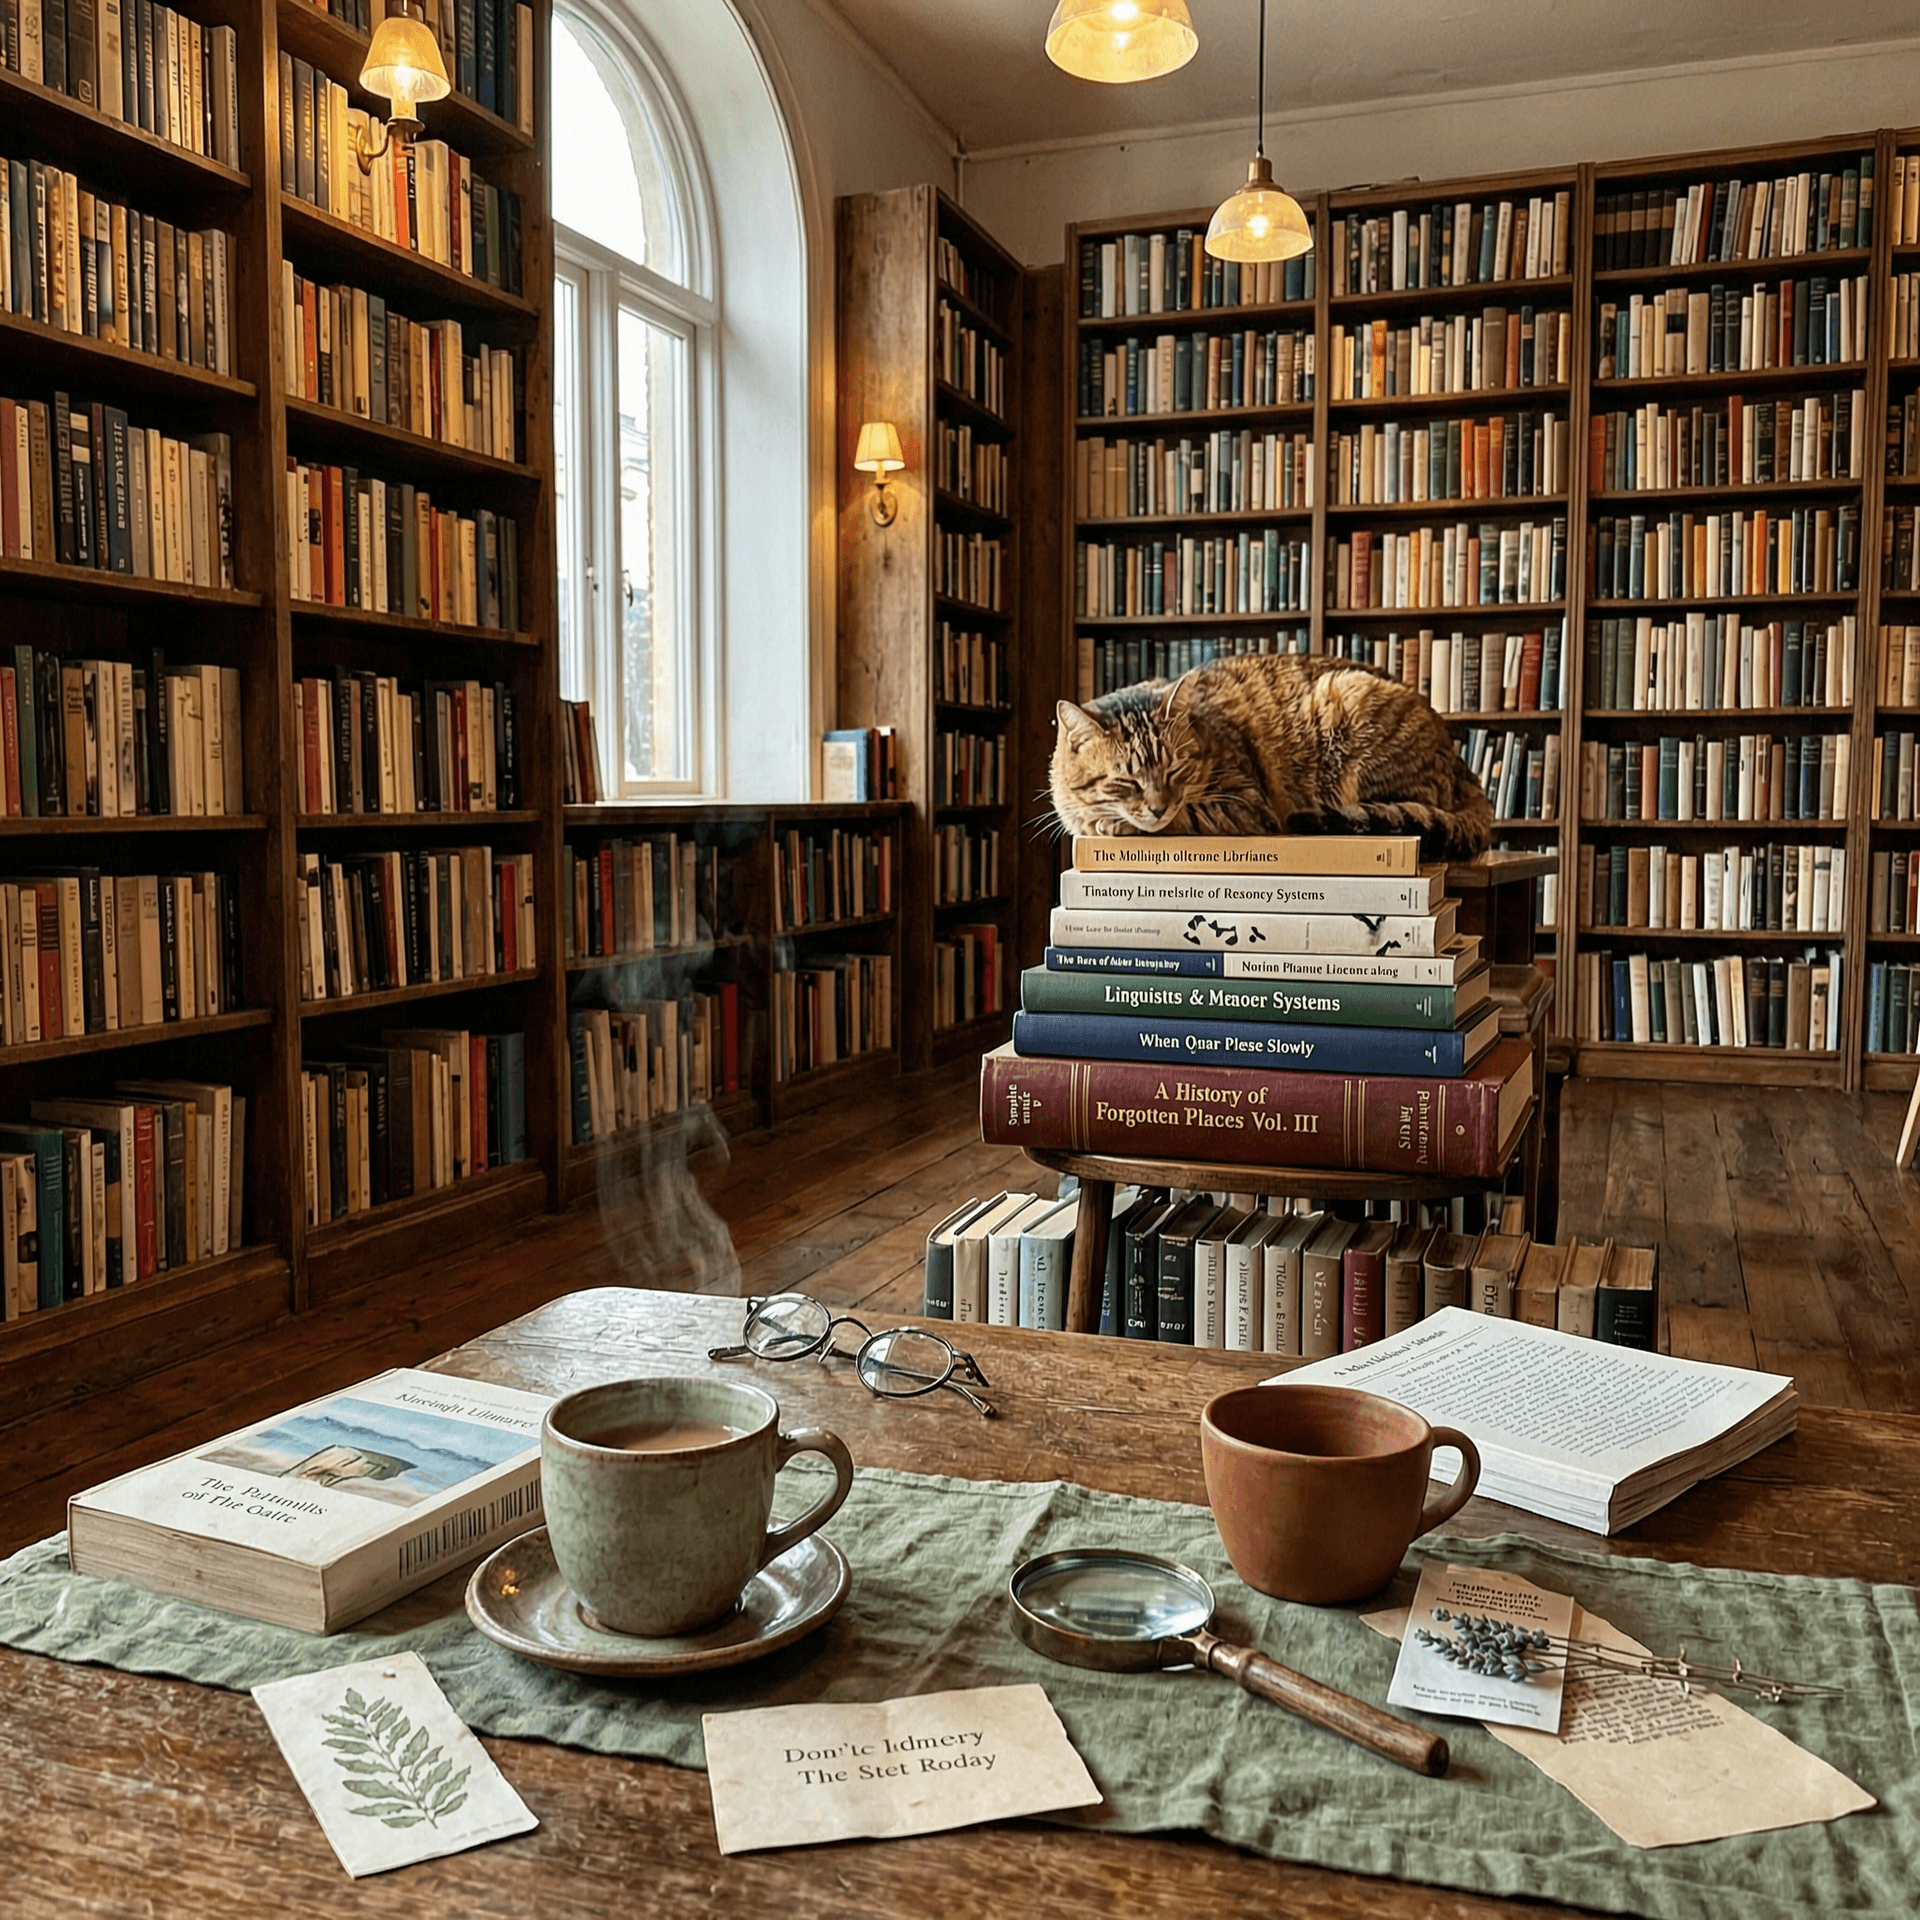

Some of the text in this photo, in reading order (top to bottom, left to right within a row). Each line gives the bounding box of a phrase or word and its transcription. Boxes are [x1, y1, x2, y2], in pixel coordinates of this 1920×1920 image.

[1094, 850, 1115, 862] The
[1208, 888, 1221, 899] of
[1277, 888, 1324, 903] Systems
[1189, 988, 1204, 1006] &
[1272, 991, 1341, 1014] Systems
[1139, 1032, 1180, 1049] When
[1266, 1038, 1314, 1058] Slowly
[1154, 1081, 1269, 1108] A History of
[1096, 1101, 1319, 1133] Forgotten Places Vol. III
[208, 1495, 244, 1511] The
[798, 1753, 997, 1785] The Stet Roday
